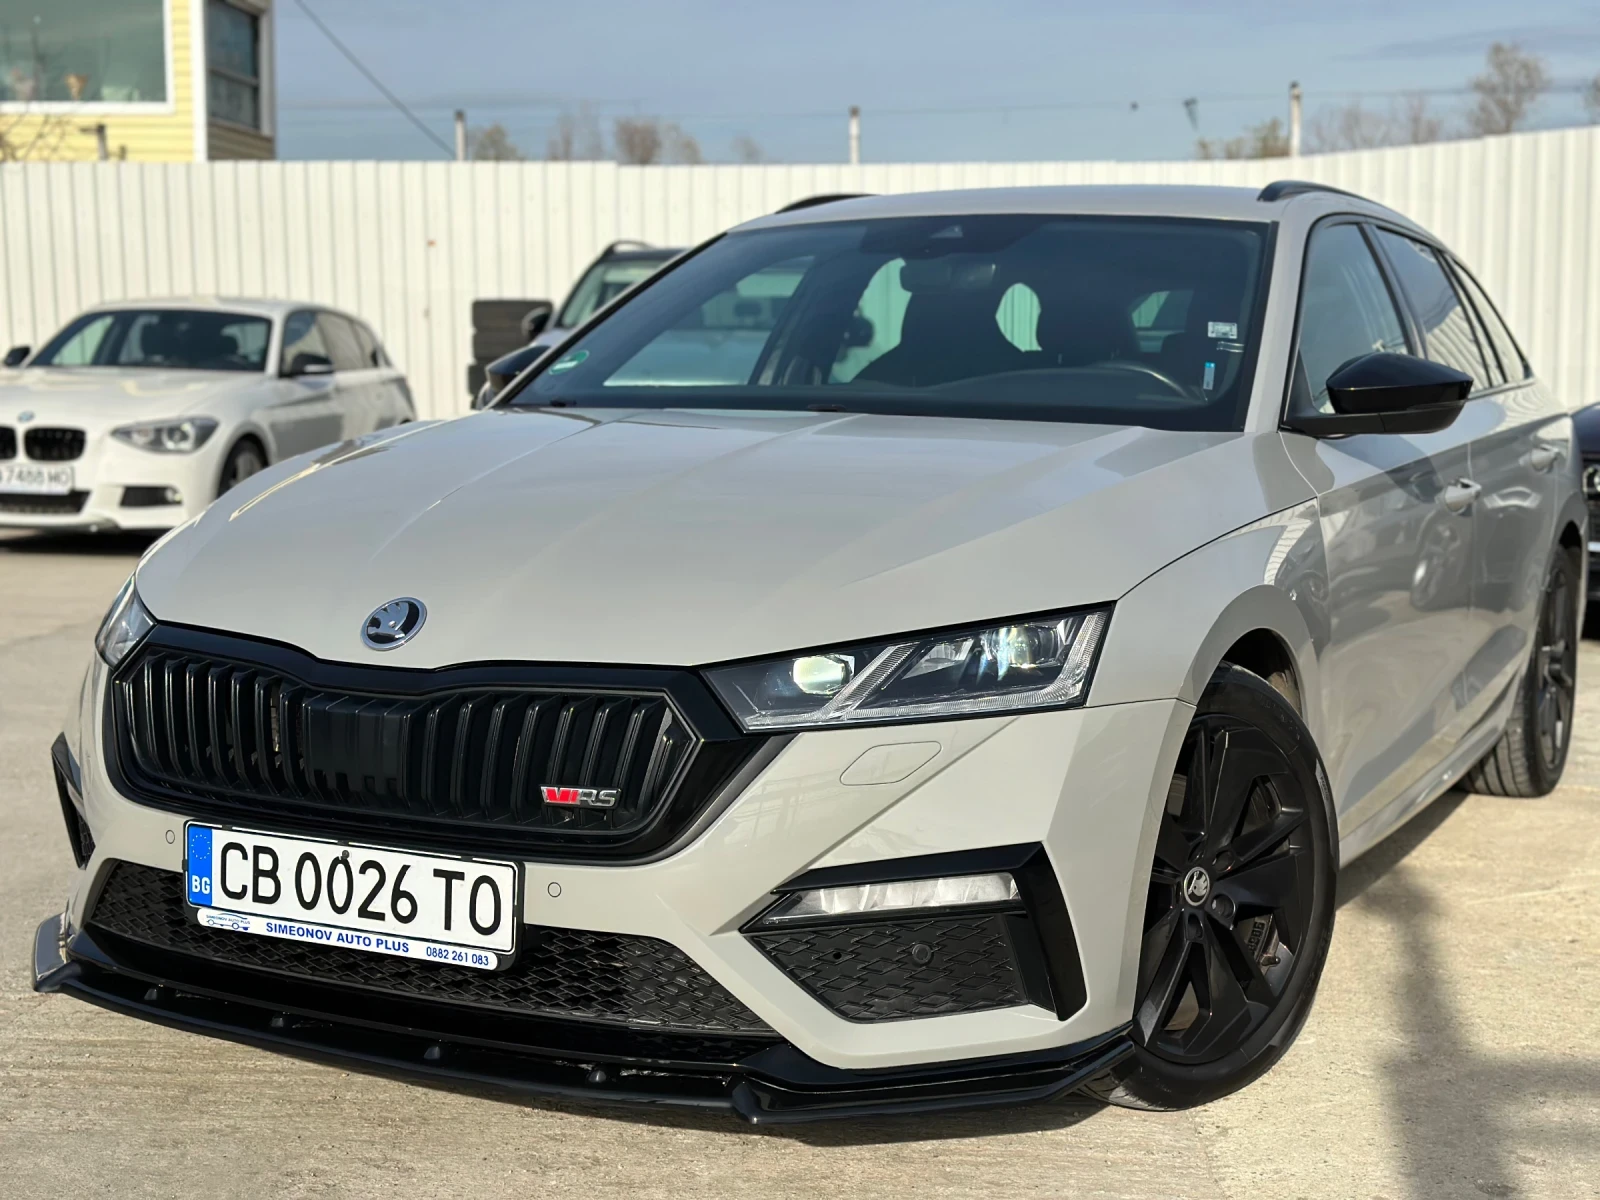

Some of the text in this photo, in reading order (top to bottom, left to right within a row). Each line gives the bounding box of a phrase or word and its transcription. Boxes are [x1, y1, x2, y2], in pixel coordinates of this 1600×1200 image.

[191, 874, 211, 895] BG
[220, 841, 502, 936] CB 0026 TO
[266, 922, 409, 953] SIMEONOV AUTO PLUS
[426, 946, 489, 966] 0882 261 083
